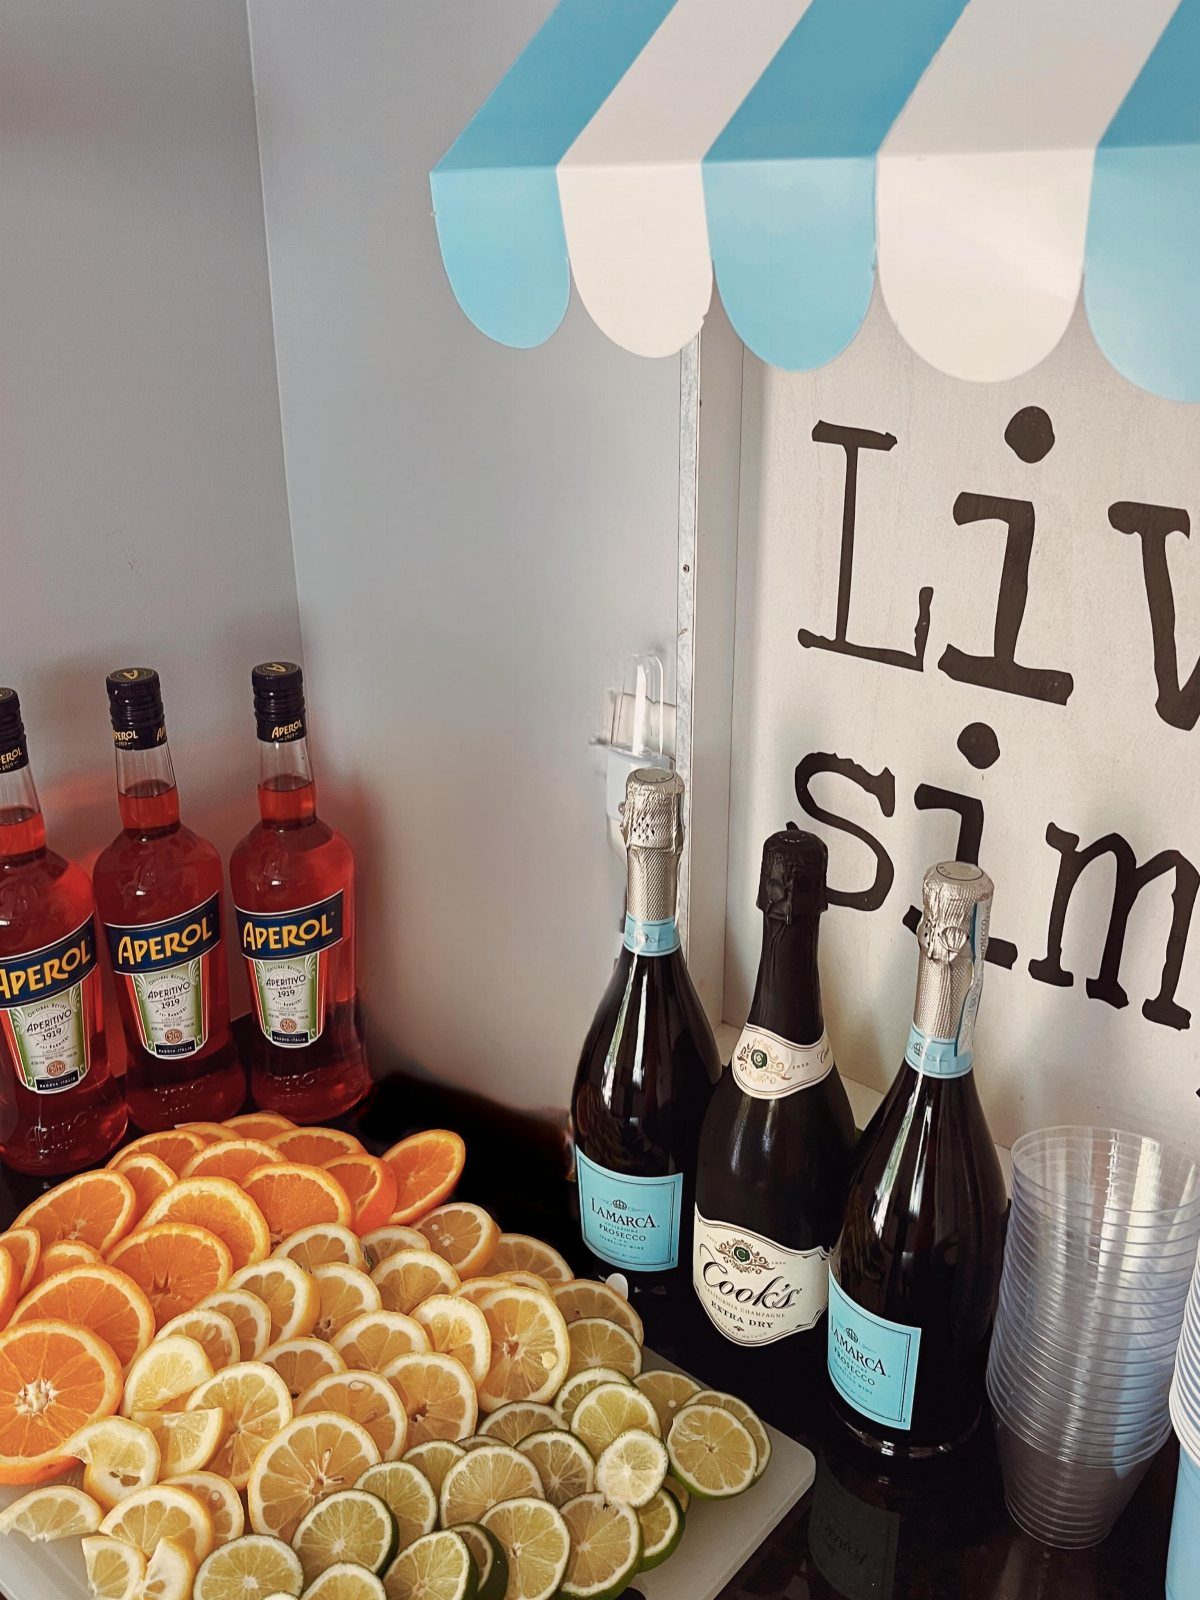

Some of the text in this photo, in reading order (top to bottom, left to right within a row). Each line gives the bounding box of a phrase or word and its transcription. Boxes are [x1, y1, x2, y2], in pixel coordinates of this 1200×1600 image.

[271, 719, 303, 739] APEROL
[0, 747, 23, 765] EROL
[118, 917, 212, 966] APEROL
[243, 914, 333, 950] APEROL
[0, 940, 91, 1000] APEROL
[265, 974, 306, 987] APERITIVO
[147, 981, 191, 1000] APERITIVO
[277, 989, 296, 998] 1919
[161, 999, 180, 1010] 1919
[27, 1009, 72, 1034] APERITIVO
[42, 1027, 62, 1042] 1919
[599, 1223, 646, 1242] PROSECCO
[700, 1243, 803, 1310] Cook's
[704, 1284, 786, 1319] CALIFORNIA CHAMPAGNE
[711, 1300, 774, 1329] EXTRA DRY
[834, 1346, 875, 1386] PROSECCO
